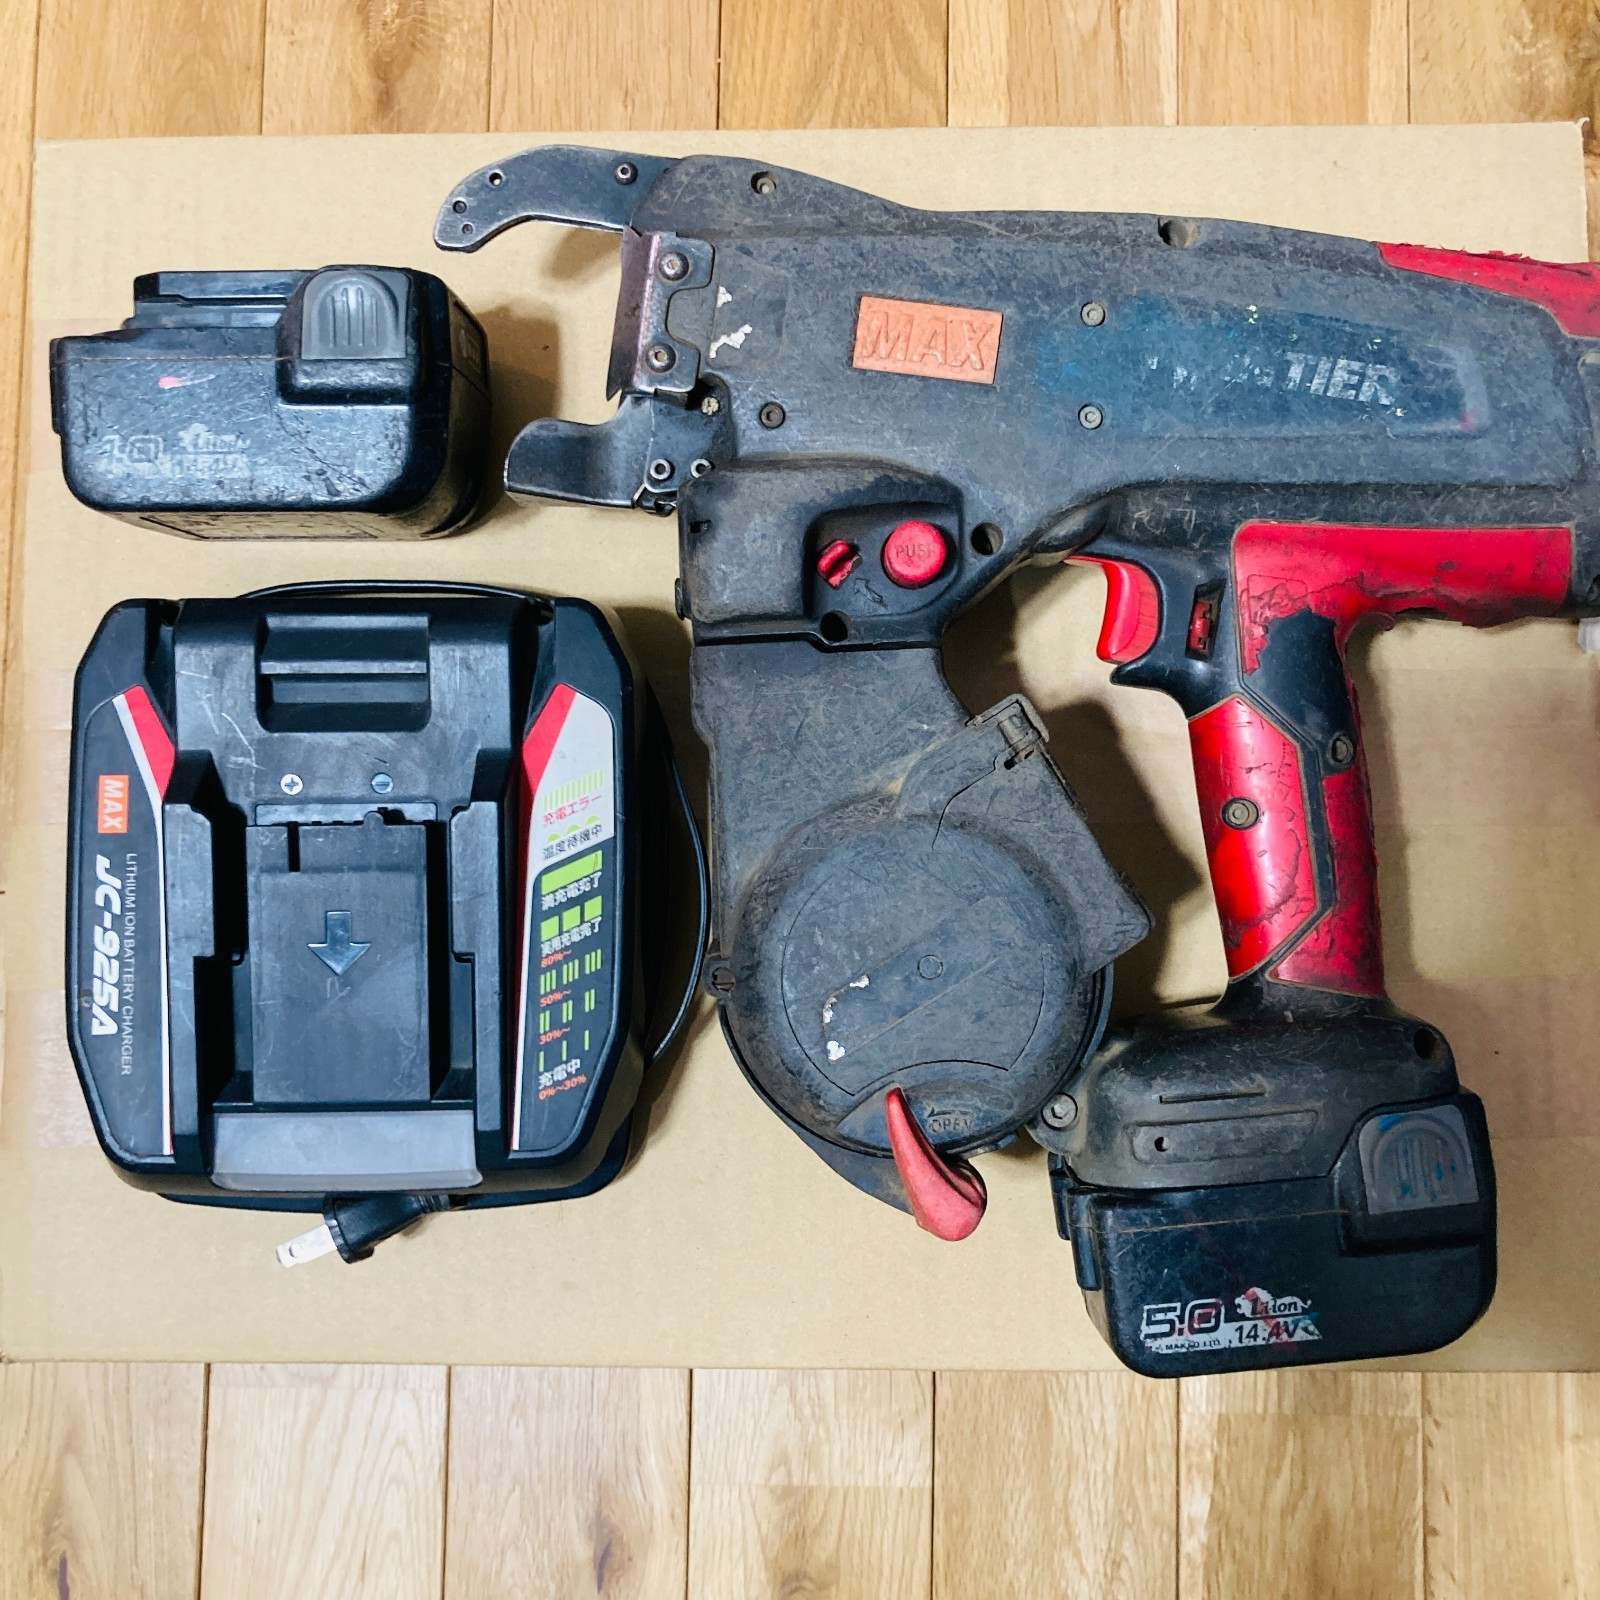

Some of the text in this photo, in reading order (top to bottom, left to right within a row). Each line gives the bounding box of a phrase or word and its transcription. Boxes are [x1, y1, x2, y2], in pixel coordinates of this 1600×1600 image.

[862, 310, 995, 371] MAX
[103, 778, 123, 830] MAX
[91, 853, 122, 1036] JC-925A
[120, 853, 138, 1076] LITHIUM ION BATTERY CHARGER
[539, 1058, 580, 1089] 充電中
[929, 1117, 974, 1133] OPEN
[1142, 1299, 1224, 1340] 5.0
[1235, 1320, 1301, 1344] 14.4V
